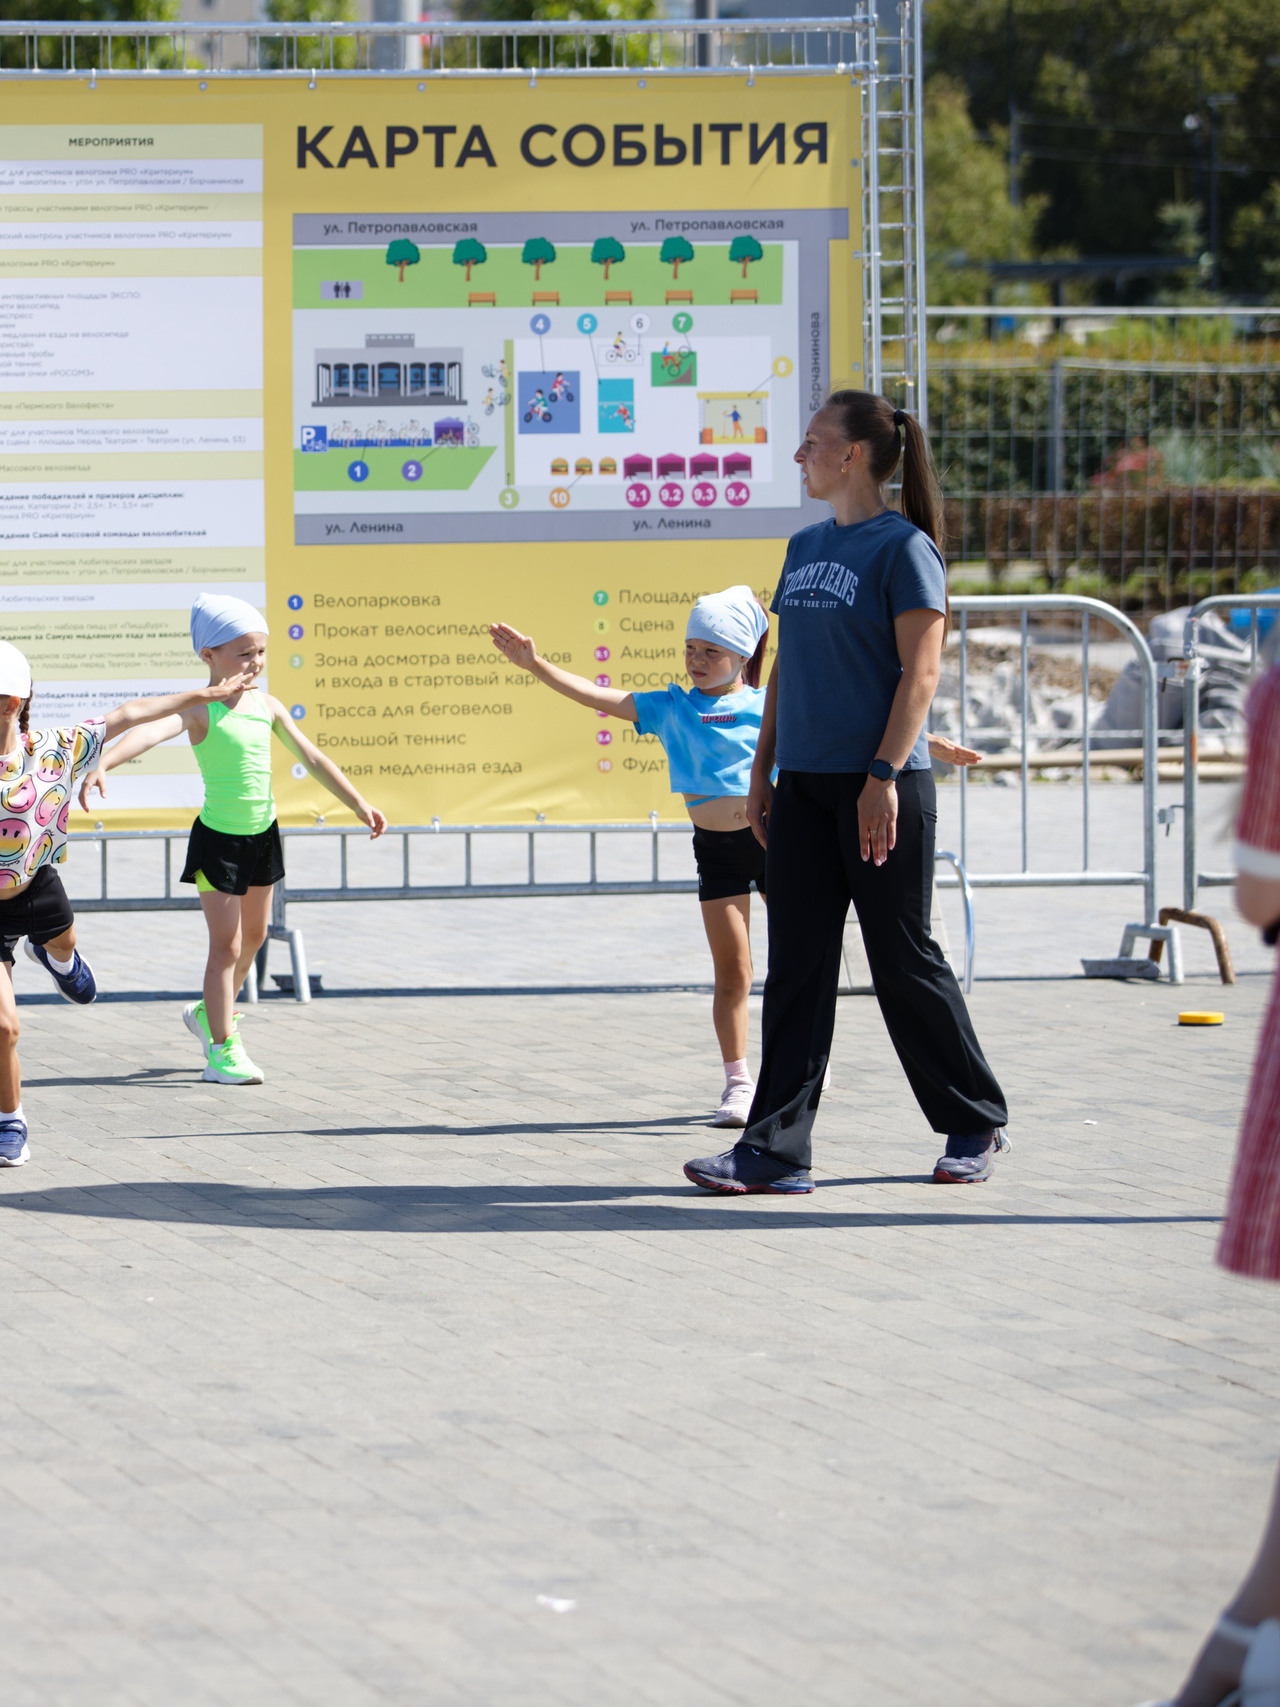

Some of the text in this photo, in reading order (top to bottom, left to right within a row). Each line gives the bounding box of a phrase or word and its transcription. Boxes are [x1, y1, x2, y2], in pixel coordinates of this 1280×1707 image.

[69, 138, 155, 147] МЕРОПРИЯТИЯ
[297, 122, 827, 168] КАРТА СОБЫТИЯ
[323, 221, 478, 235] ул. Петропавловская
[631, 218, 784, 233] ул. Петропавловская
[536, 318, 545, 330] 4
[583, 318, 592, 330] 5
[636, 318, 643, 329] 6
[678, 317, 687, 328] 7
[302, 428, 316, 444] P
[353, 466, 362, 477] 1
[407, 465, 417, 477] 2
[505, 493, 513, 504] 3
[551, 492, 568, 504] 10
[627, 489, 647, 501] 9.1
[660, 489, 681, 501] 9.2
[693, 488, 714, 500] 9.3
[727, 488, 747, 500] 9.4
[325, 521, 404, 534] ул. Ленина
[633, 517, 711, 532] ул. Ленина
[784, 562, 828, 596] TOMMY
[819, 562, 859, 607] JEANS
[292, 594, 441, 609] 1 Велопарковка
[803, 600, 820, 608] YORK
[822, 601, 838, 609] CITY
[292, 623, 489, 639] 2 Прокат велосипедо
[620, 618, 674, 632] Сцена
[620, 645, 676, 660] Акция
[315, 652, 357, 667] Зона
[364, 652, 449, 668] досмотра
[315, 677, 325, 688] и
[332, 675, 382, 689] входа
[389, 676, 398, 687] в
[404, 671, 499, 687] стартовый
[621, 672, 692, 688] РОСОМ
[294, 701, 513, 719] 4 Трасса для беговелов
[701, 711, 736, 724] dream
[317, 732, 466, 747] Большой теннис
[340, 764, 373, 776] мая
[379, 762, 476, 776] медленная
[482, 761, 522, 775] езда
[622, 757, 666, 772] Фудт
